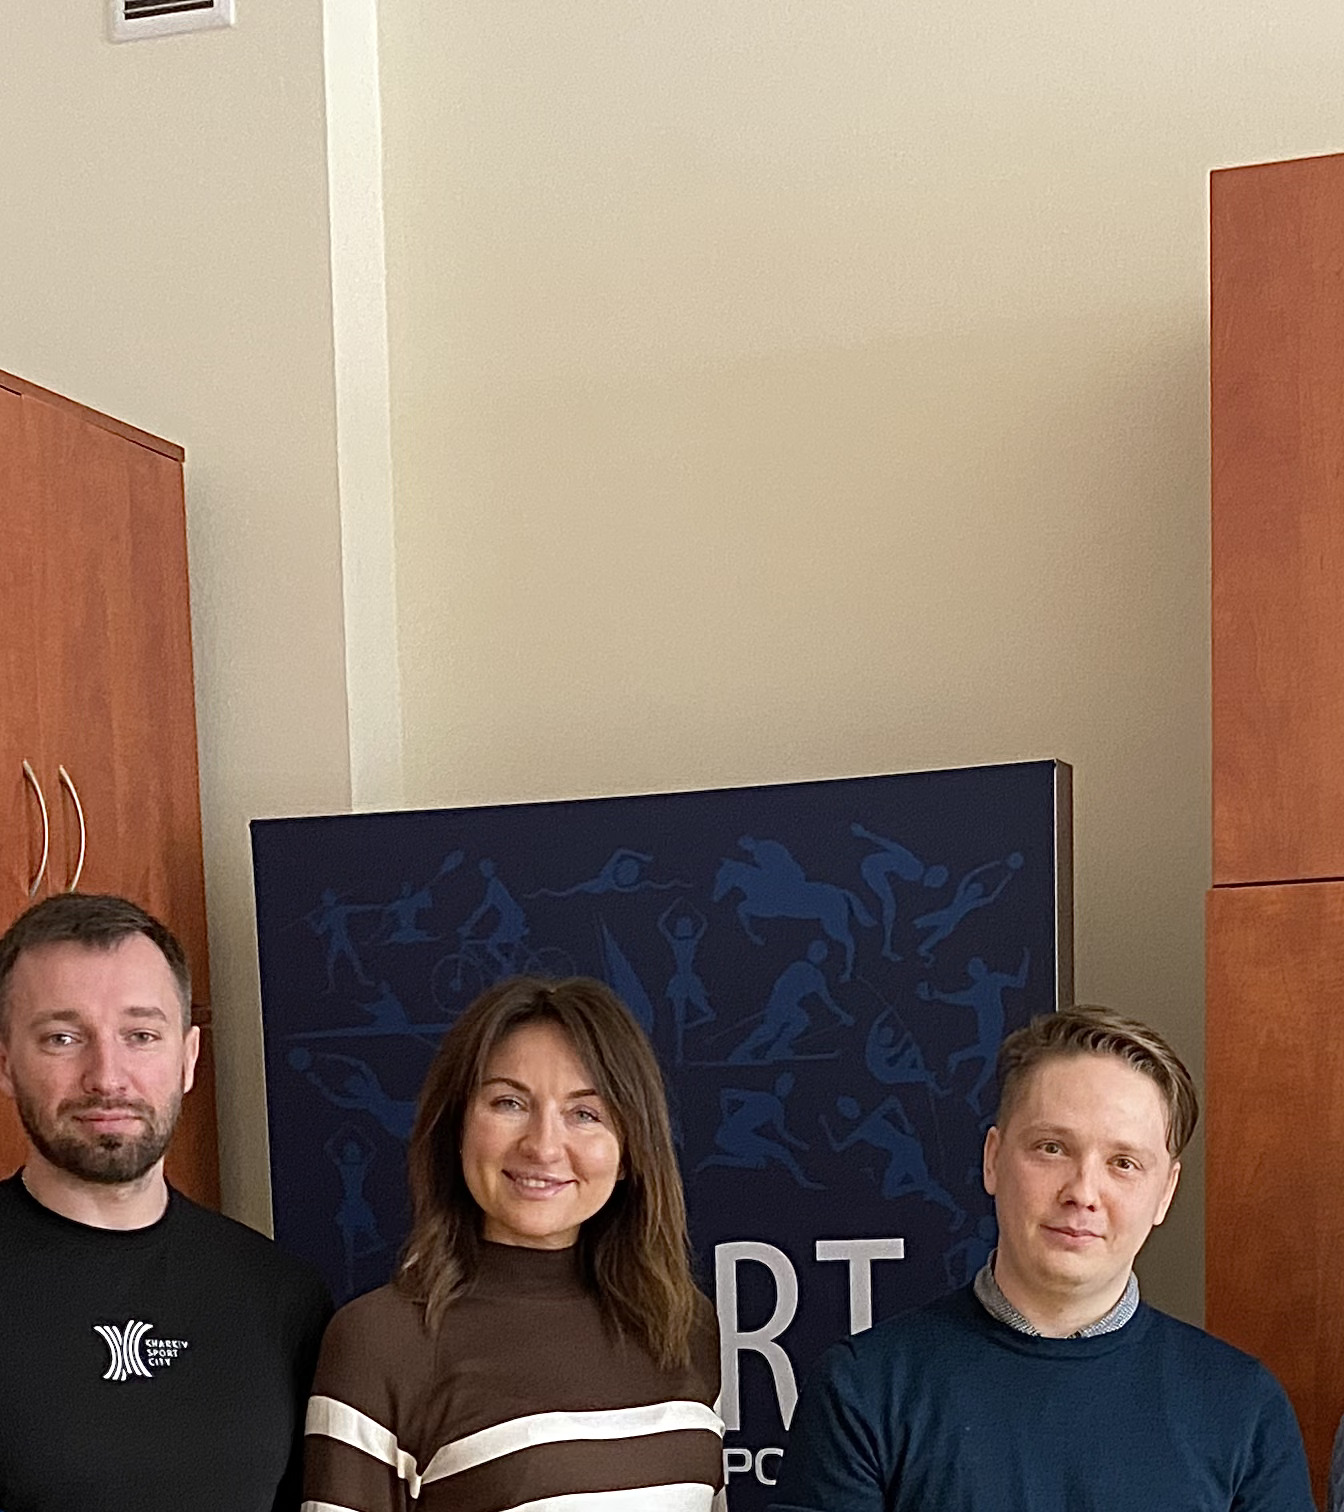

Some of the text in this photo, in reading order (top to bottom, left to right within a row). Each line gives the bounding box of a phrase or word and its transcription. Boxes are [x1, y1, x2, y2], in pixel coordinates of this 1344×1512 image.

[145, 1339, 189, 1349] KHARKIV
[146, 1348, 179, 1358] SPORT
[148, 1357, 171, 1367] CITY
